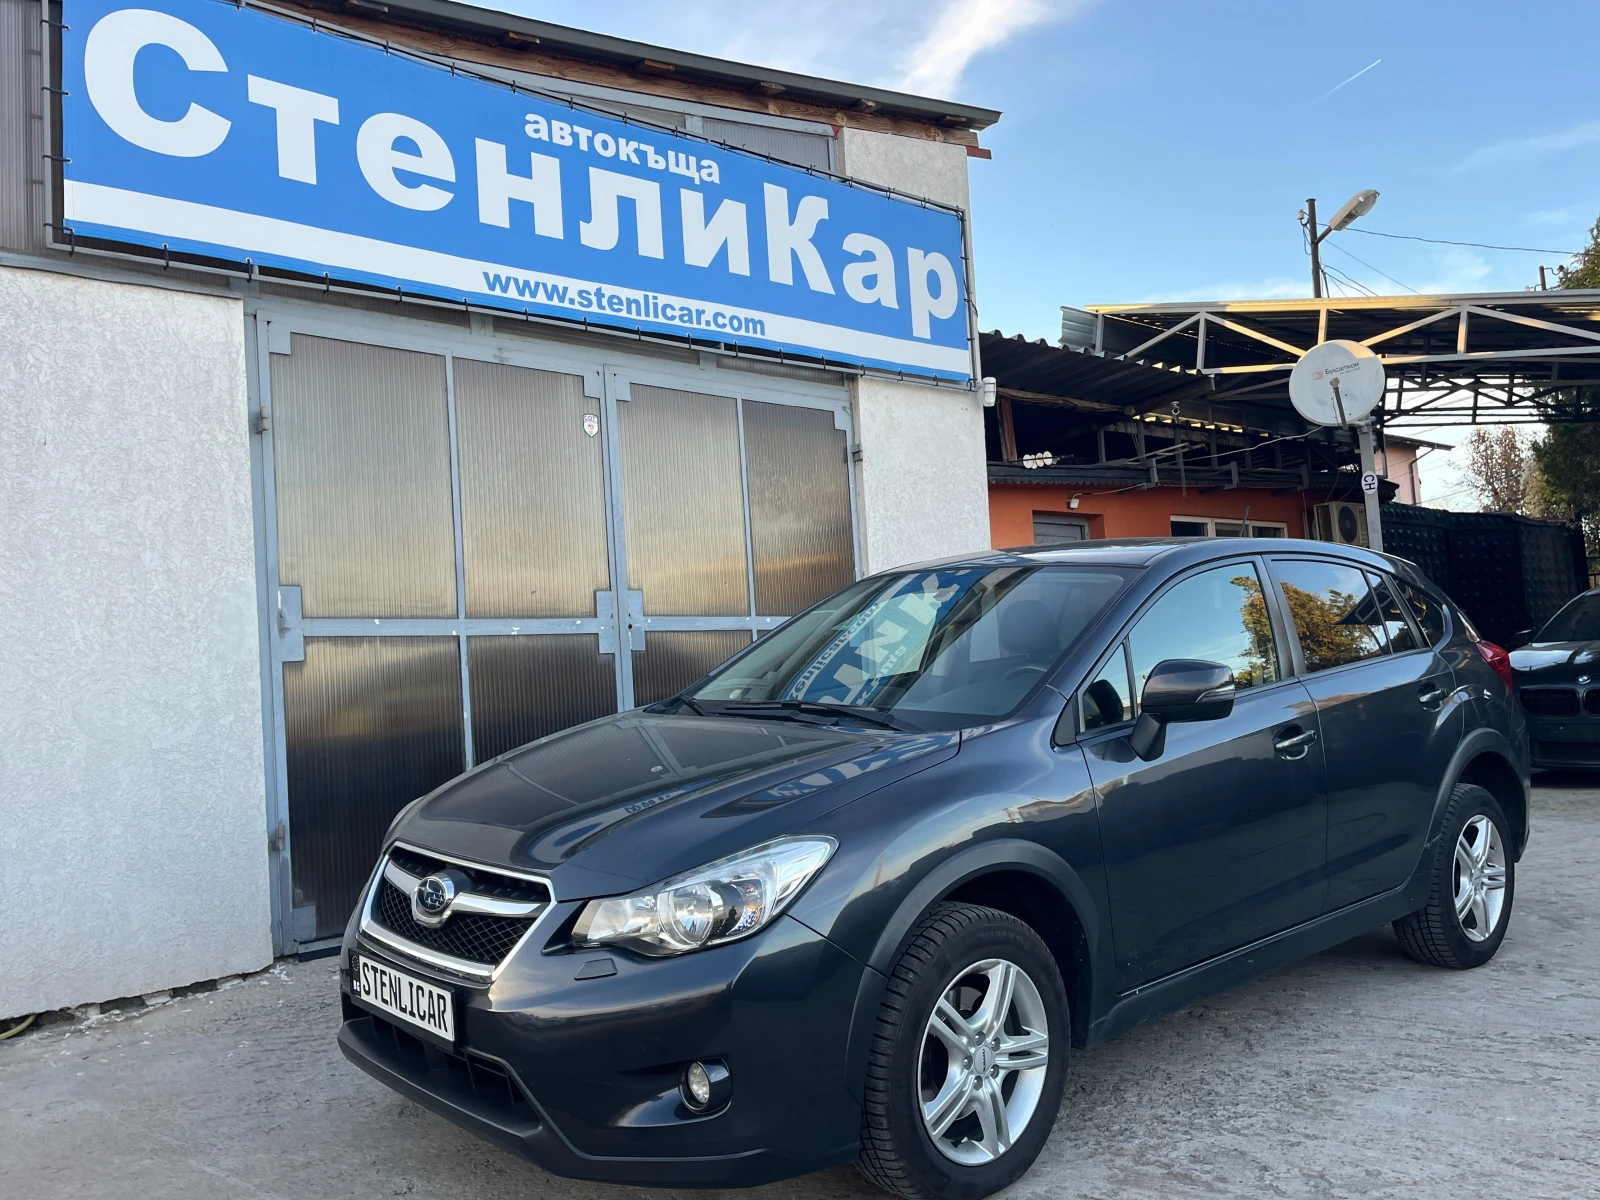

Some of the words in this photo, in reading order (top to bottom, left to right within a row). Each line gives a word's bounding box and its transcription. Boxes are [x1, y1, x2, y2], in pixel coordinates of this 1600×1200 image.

[84, 8, 958, 339] СтенлиКар
[524, 113, 720, 184] автокъща
[482, 271, 766, 336] www.stenlicar.com
[1363, 474, 1376, 490] CH
[362, 962, 448, 1033] STENLICAR
